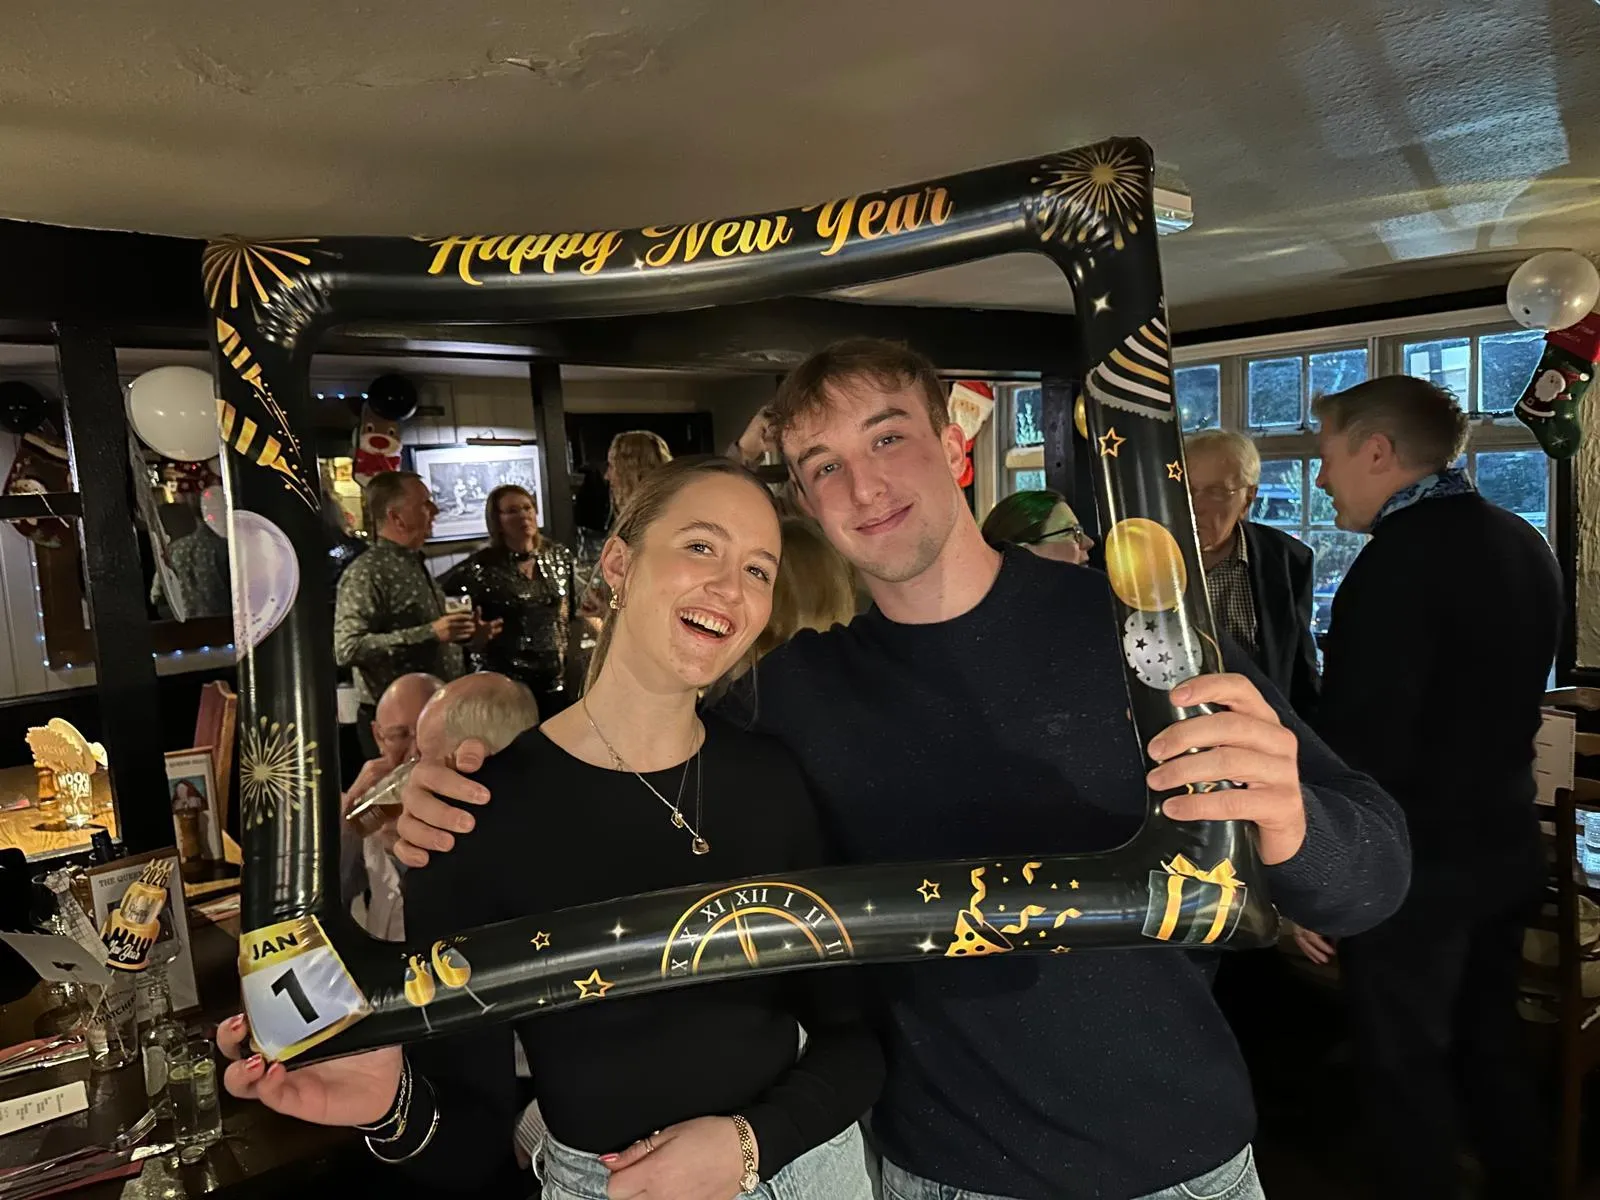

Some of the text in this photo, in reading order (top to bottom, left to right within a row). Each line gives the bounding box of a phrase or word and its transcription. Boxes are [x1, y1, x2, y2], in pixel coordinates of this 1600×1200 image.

[411, 187, 954, 286] Happy New Year
[98, 873, 116, 888] THE
[139, 865, 170, 888] 2026
[735, 888, 768, 906] XII
[700, 899, 726, 923] XI
[804, 906, 826, 929] II
[252, 932, 299, 961] JAN
[271, 968, 320, 1024] 1
[92, 994, 136, 1023] THATCHER
